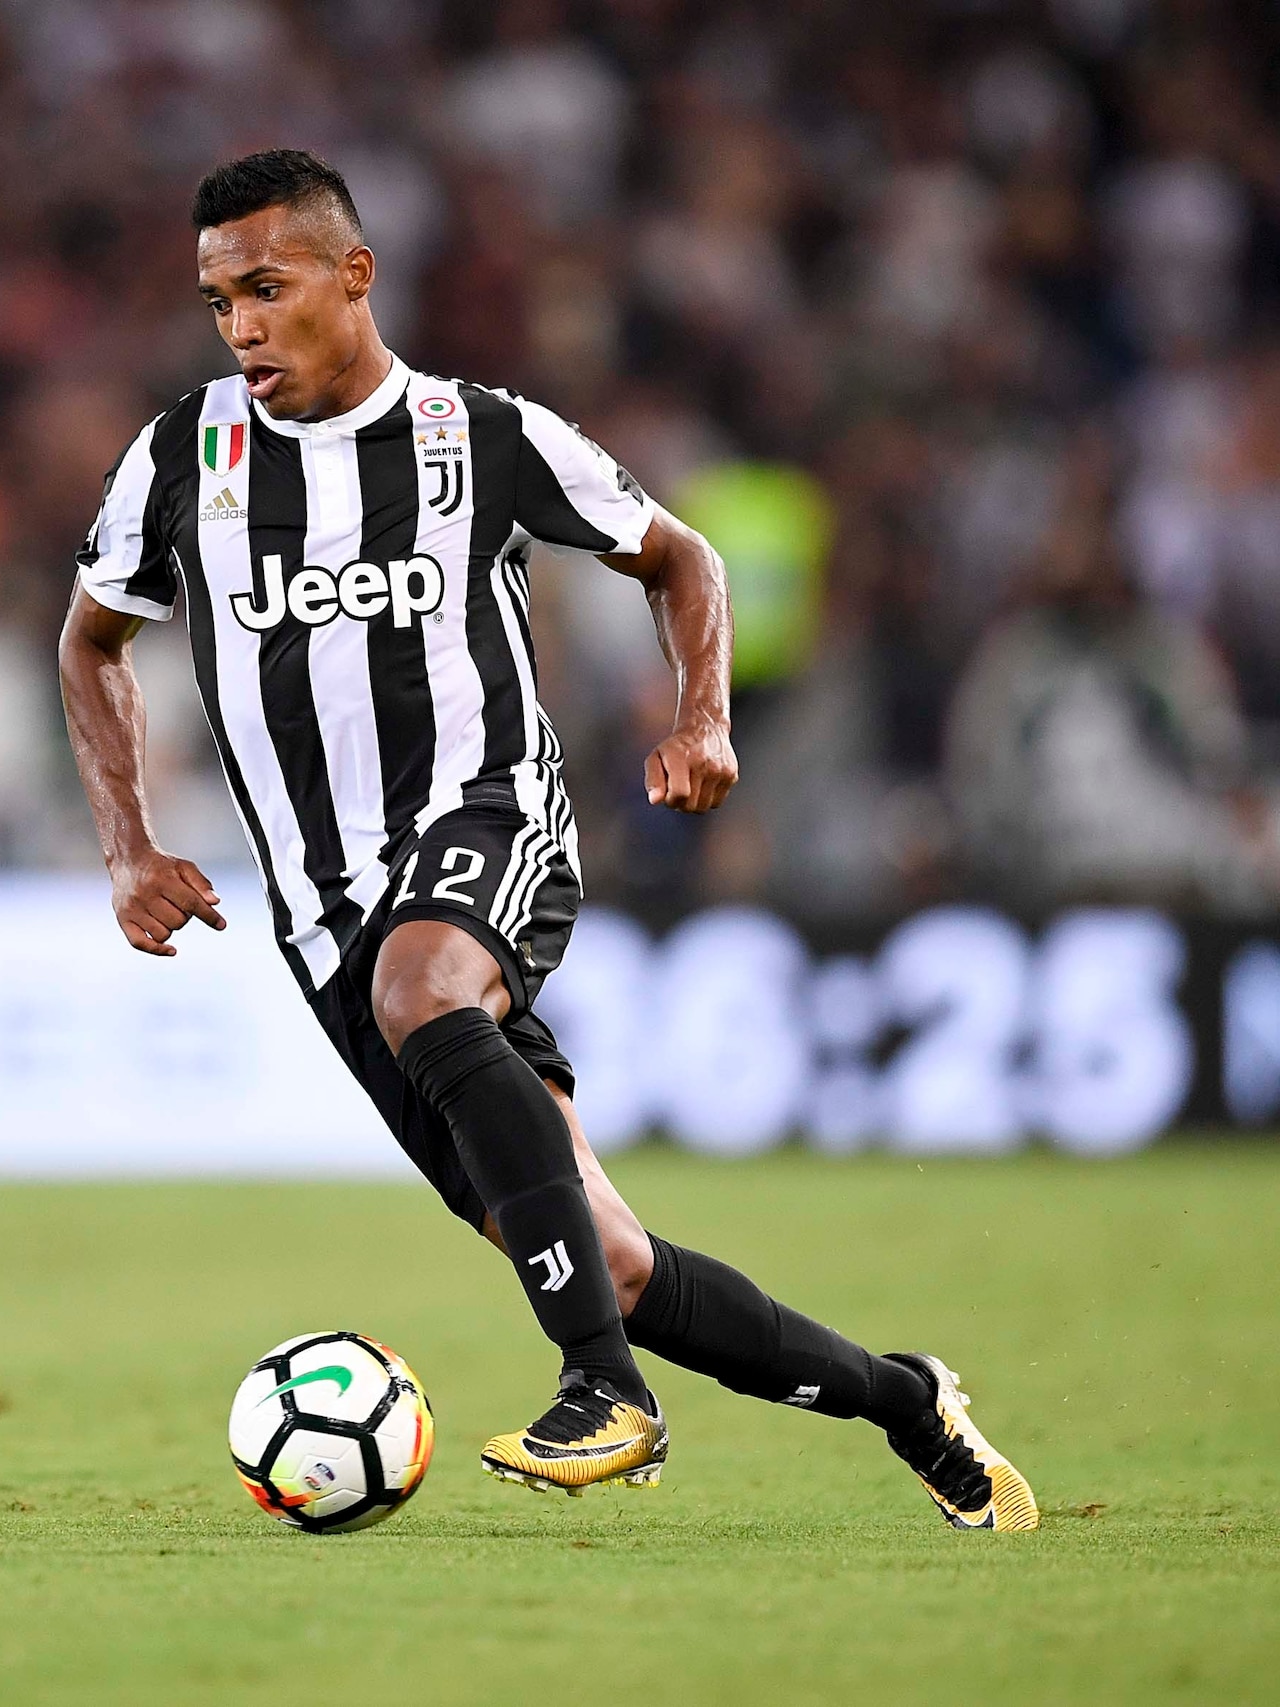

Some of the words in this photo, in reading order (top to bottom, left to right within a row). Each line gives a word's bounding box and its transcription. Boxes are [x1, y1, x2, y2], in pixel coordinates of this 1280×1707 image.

[423, 447, 463, 457] JUVENTUS
[199, 507, 247, 522] adidas
[230, 553, 437, 629] Jeep
[392, 846, 486, 911] 12
